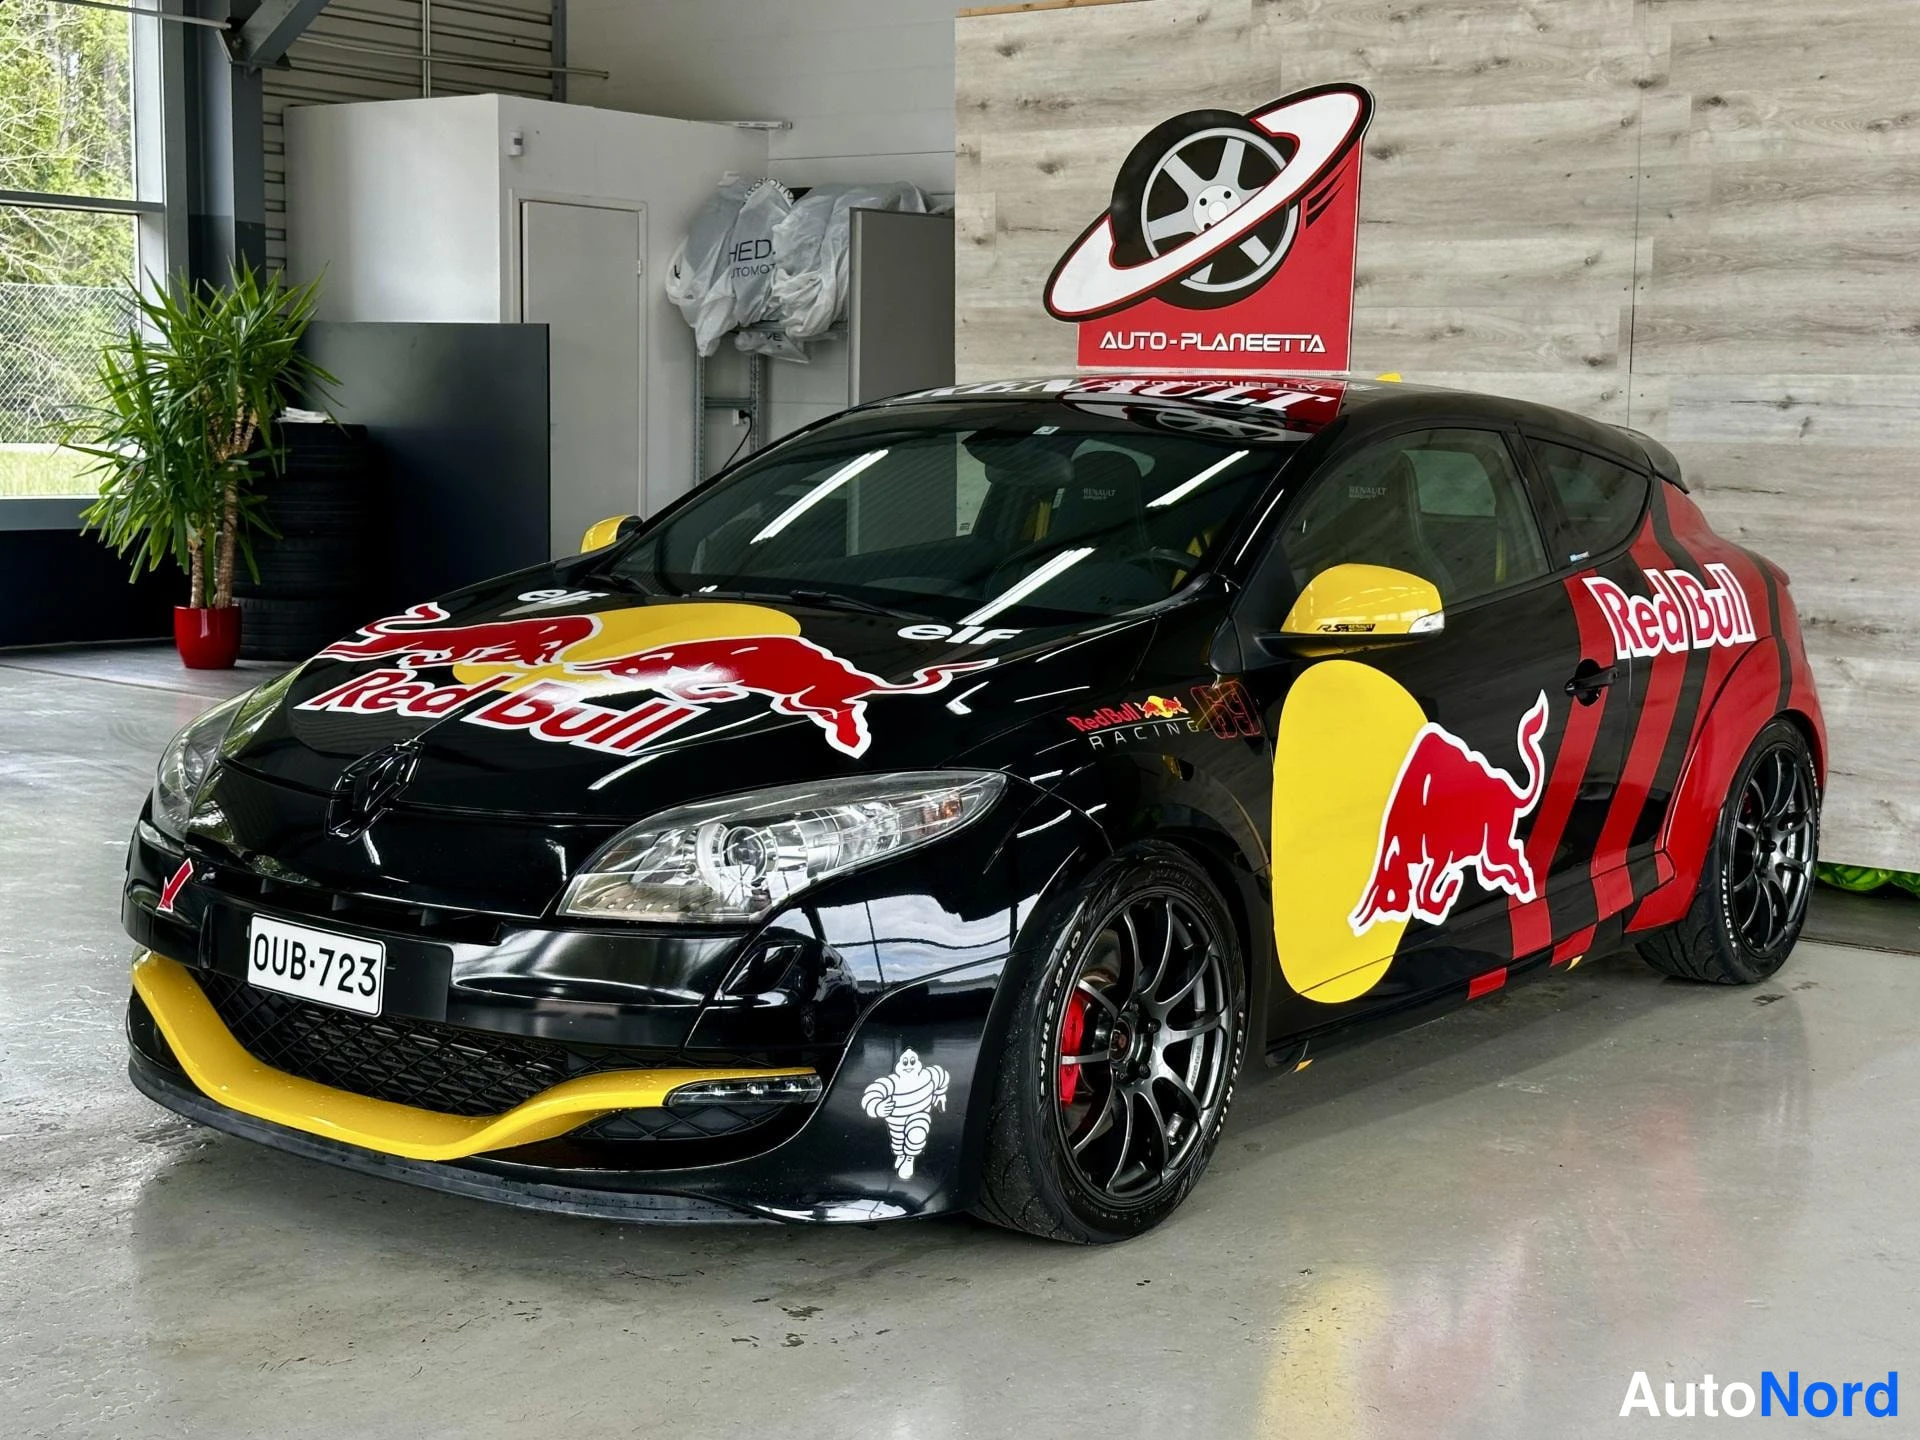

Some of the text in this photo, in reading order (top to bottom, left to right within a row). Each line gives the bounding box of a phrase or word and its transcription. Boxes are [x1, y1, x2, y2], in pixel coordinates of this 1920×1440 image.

[1099, 331, 1326, 353] AUTO-PLANEETTA
[517, 589, 611, 604] elf
[897, 624, 1024, 645] elf
[293, 668, 711, 756] Red Bull
[1088, 720, 1200, 750] RACING
[253, 932, 378, 997] OUB-723
